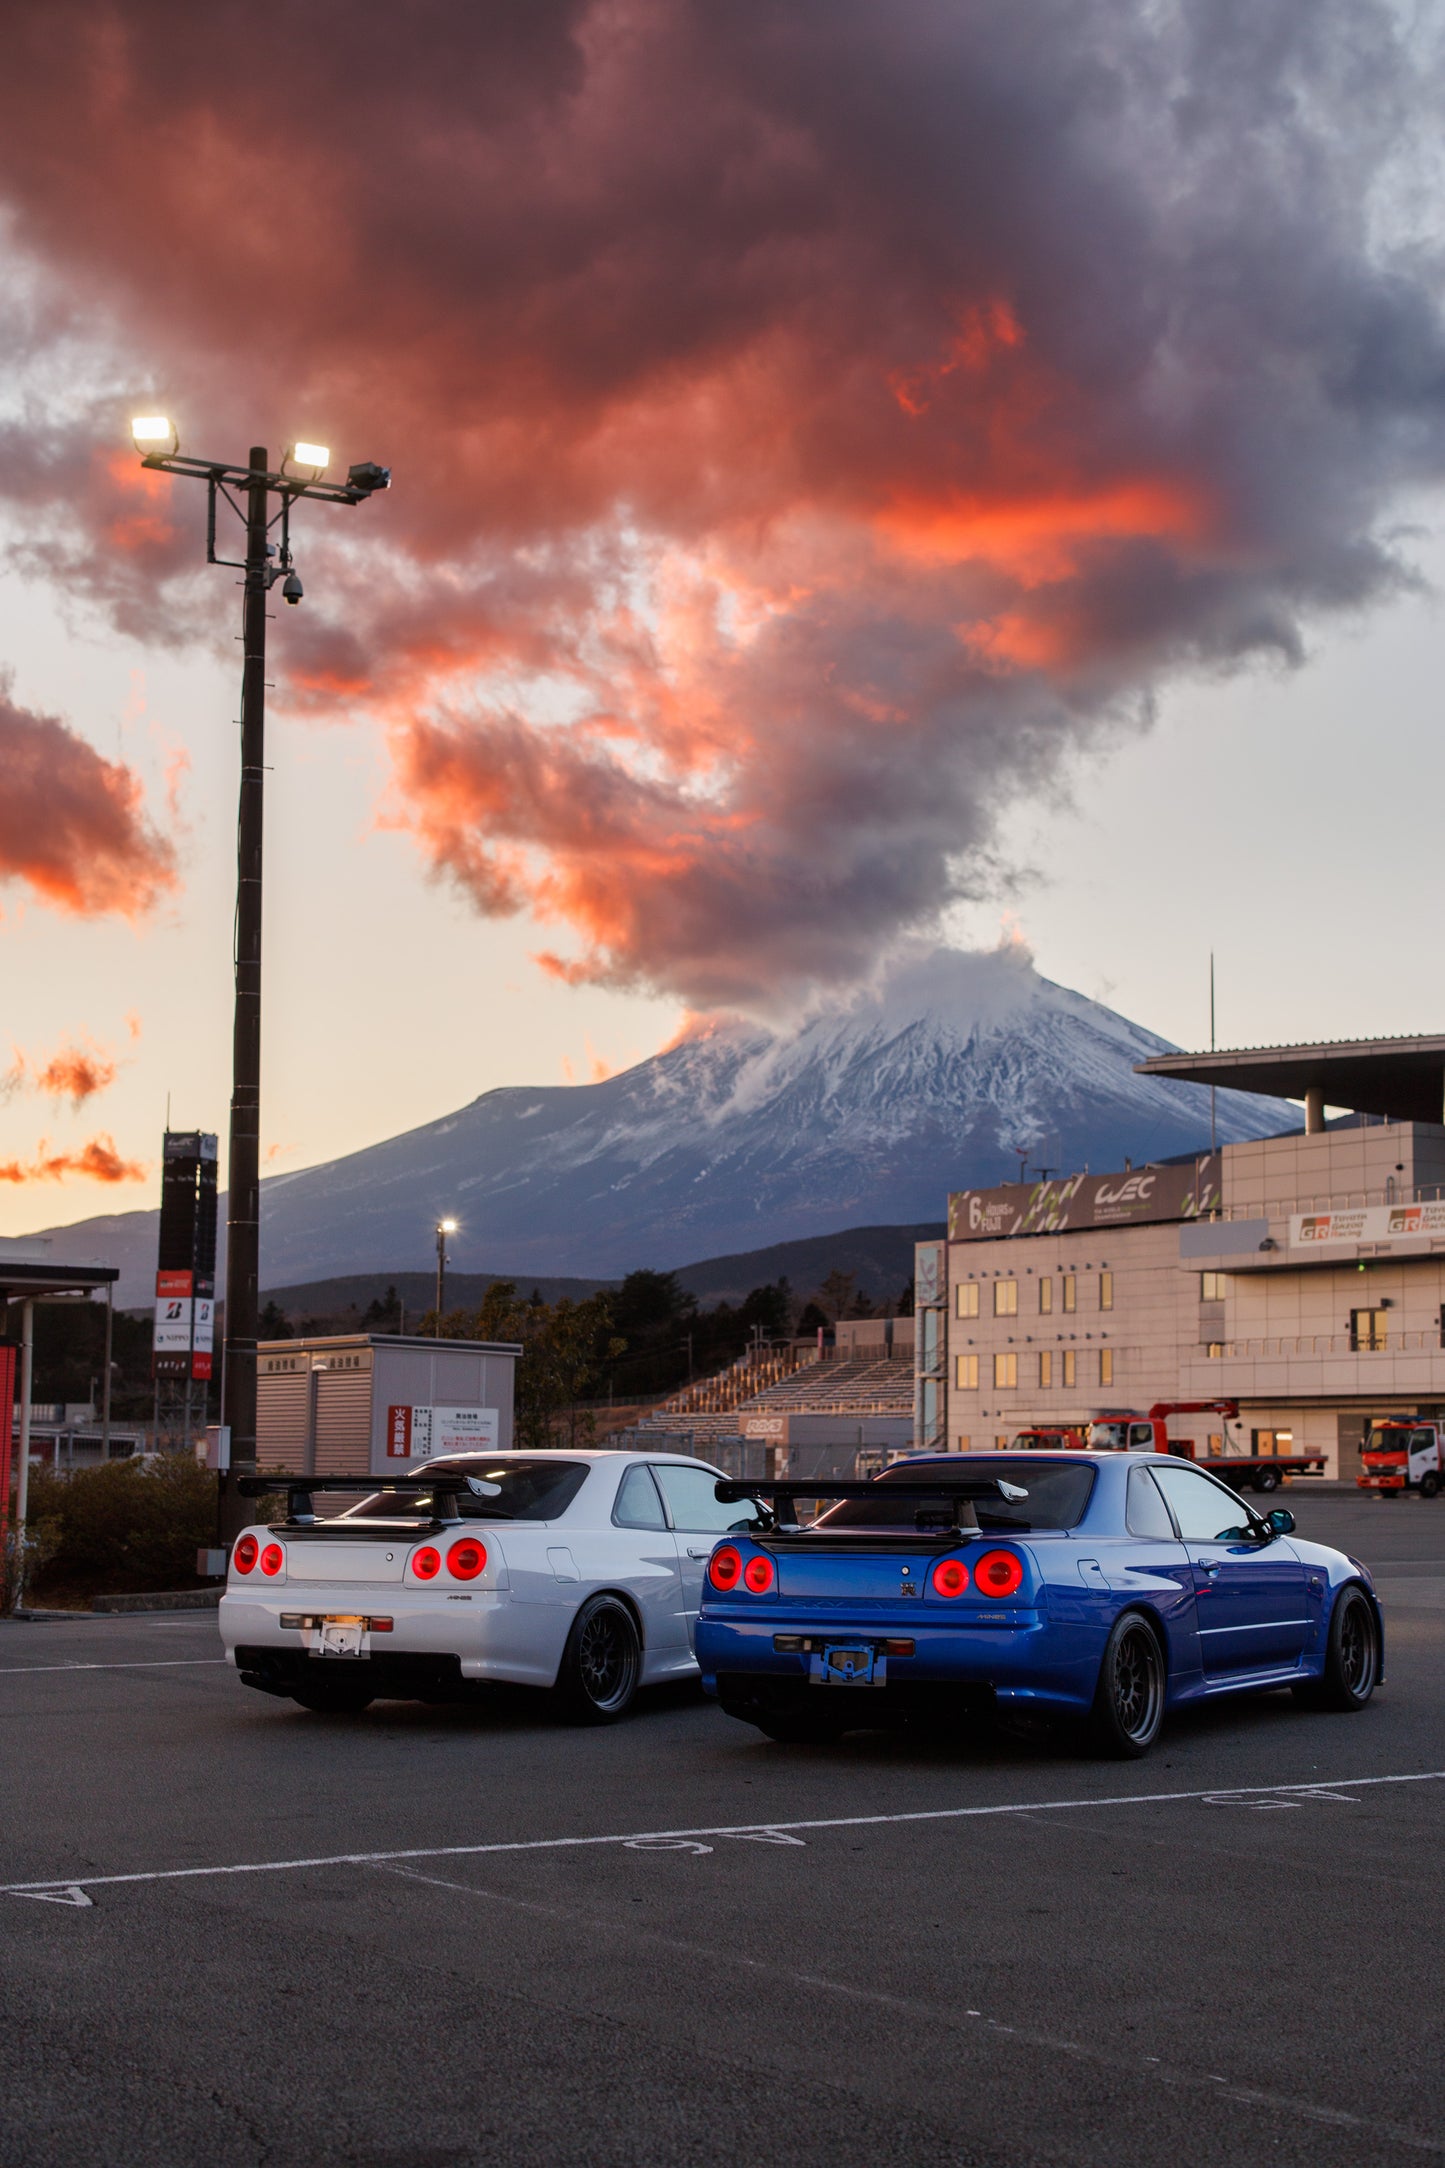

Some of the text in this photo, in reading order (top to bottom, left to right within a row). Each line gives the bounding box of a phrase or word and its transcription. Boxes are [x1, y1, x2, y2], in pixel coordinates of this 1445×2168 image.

[1094, 1175, 1156, 1204] WEC
[969, 1196, 982, 1231] 6
[1333, 1213, 1368, 1222] TOYOTA
[981, 1216, 1001, 1232] FUJI
[1389, 1217, 1420, 1233] GR
[1300, 1225, 1328, 1241] GR
[1330, 1230, 1362, 1238] Racing
[746, 1418, 784, 1433] RAYS
